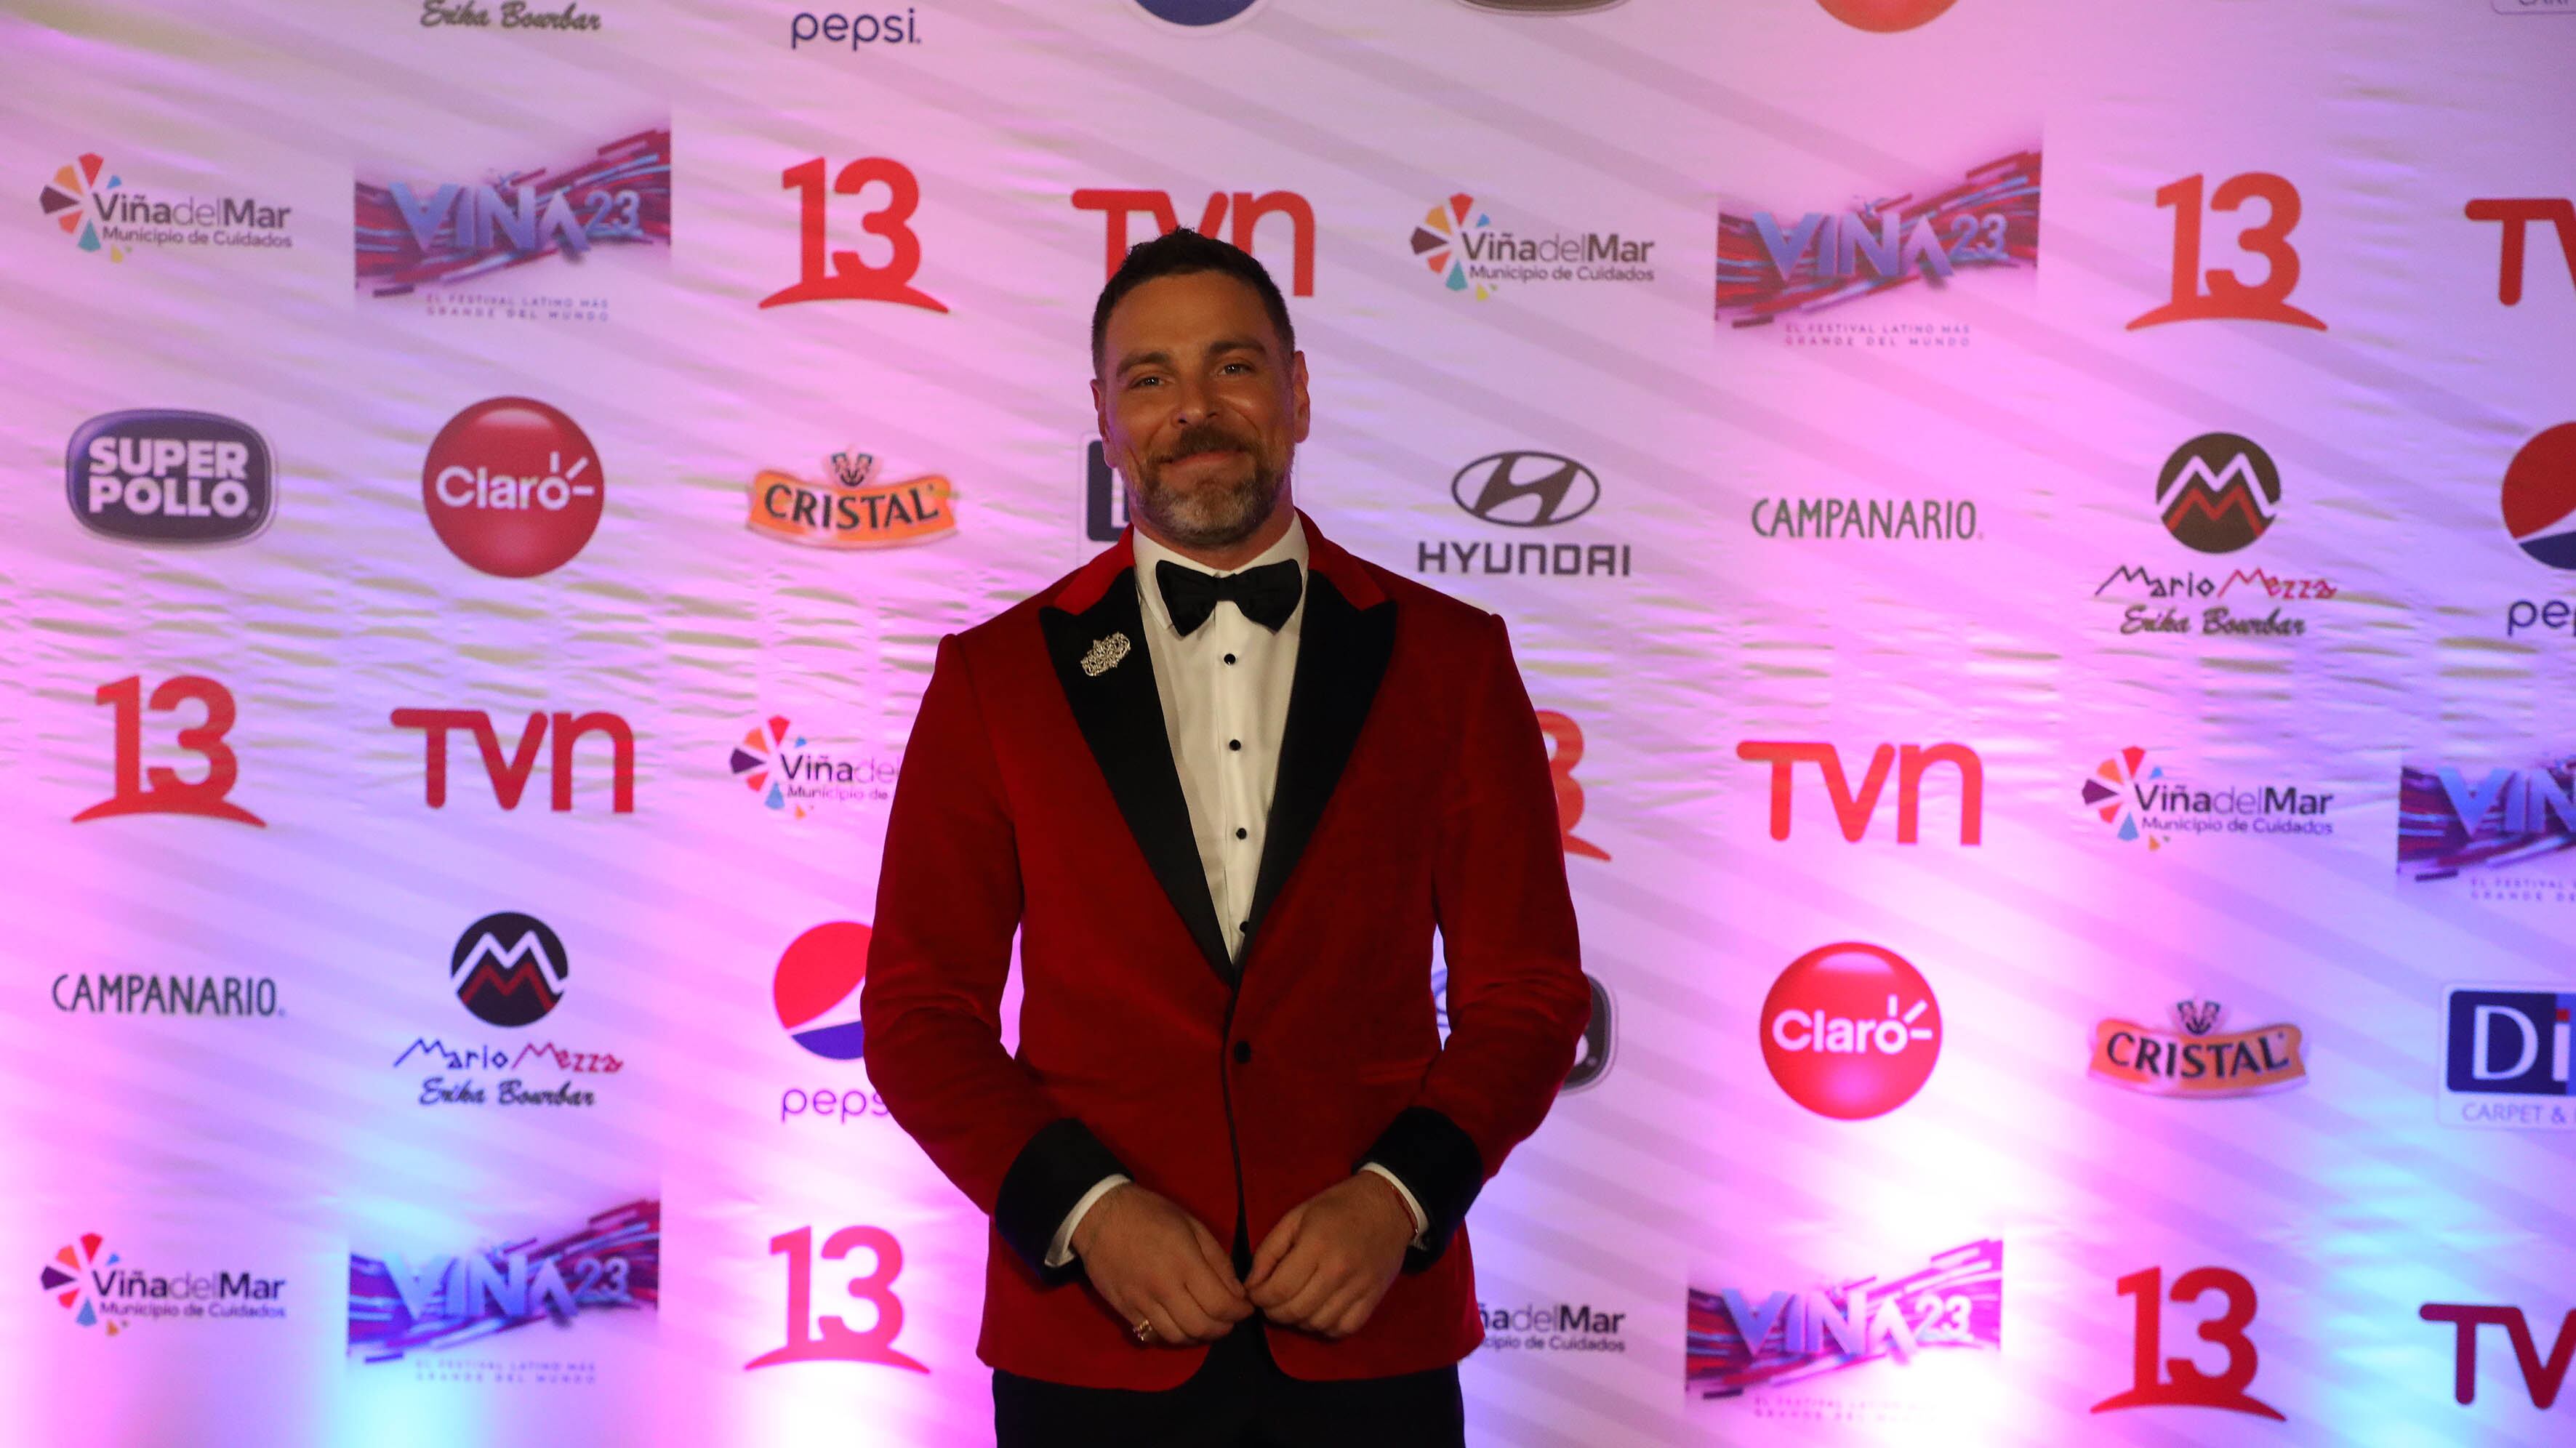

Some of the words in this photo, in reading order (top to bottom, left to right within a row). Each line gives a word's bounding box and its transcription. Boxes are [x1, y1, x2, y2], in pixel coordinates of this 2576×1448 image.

[792, 8, 917, 51] pepsi
[92, 193, 292, 228] ViñadelMar
[782, 157, 922, 293] 13
[103, 226, 183, 246] Municipio
[188, 229, 209, 245] de
[213, 230, 292, 248] Cuidados
[1461, 231, 1656, 263] ViñadelMar
[2156, 172, 2302, 304] 13
[1469, 265, 1548, 283] Municipio
[1552, 266, 1572, 281] de
[1578, 265, 1655, 282] Cuidados
[89, 436, 249, 480] SUPER
[89, 475, 249, 518] POLLO
[436, 465, 571, 511] Claro
[765, 483, 939, 530] CRISTAL
[1751, 498, 1976, 540] CAMPANARIO
[1417, 541, 1631, 577] HYUNDAI
[2095, 565, 2215, 598] Mario
[2217, 567, 2338, 600] Mezza
[95, 675, 237, 799] 13
[2135, 784, 2334, 816] ViñadelMar
[2142, 816, 2222, 834] Municipio
[2227, 817, 2248, 832] de
[2253, 817, 2333, 834] Cuidados
[52, 973, 276, 1016] CAMPANARIO
[1772, 1009, 1909, 1055] Claro
[393, 1039, 508, 1069] Mario
[511, 1042, 624, 1073] Mezza
[2107, 1031, 2290, 1079] CRISTAL
[782, 1088, 888, 1124] peps
[2462, 1101, 2543, 1125] CARPET
[769, 1225, 904, 1349] 13
[100, 1302, 179, 1319] Municipio
[183, 1303, 204, 1317] de
[2116, 1266, 2259, 1393] 13
[1524, 1336, 1544, 1349] de
[1548, 1335, 1626, 1353] Cuidados
